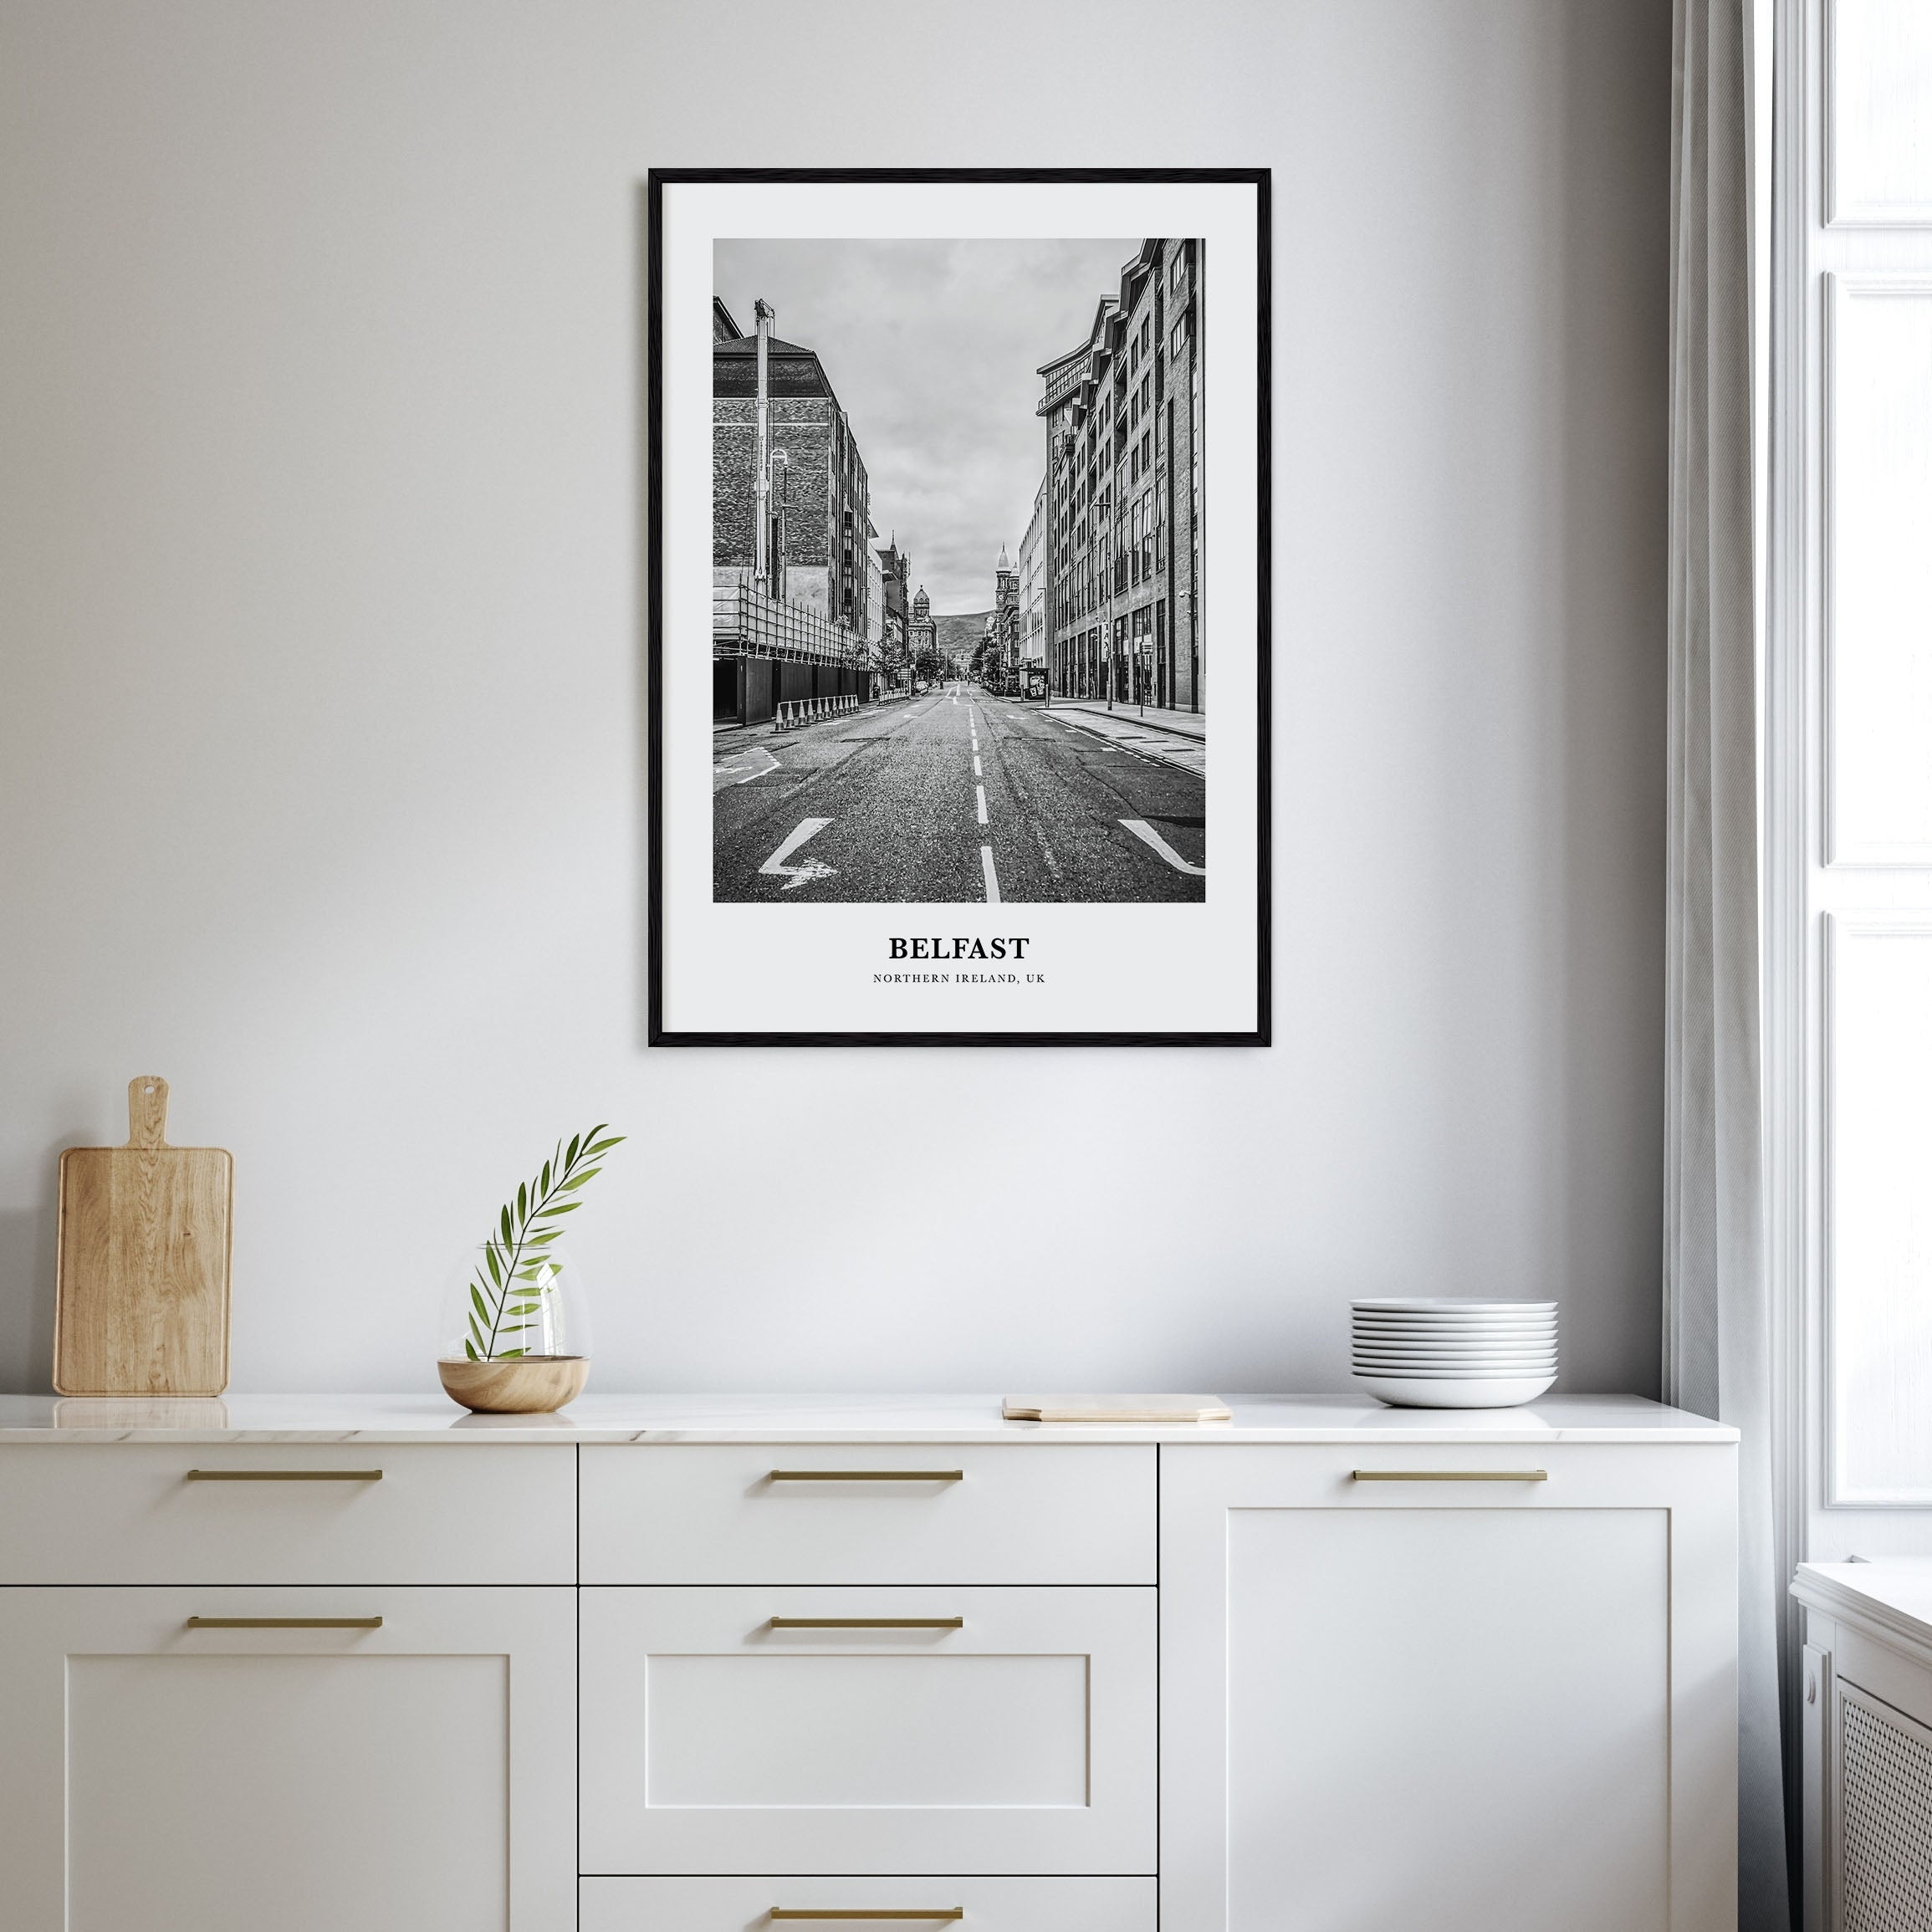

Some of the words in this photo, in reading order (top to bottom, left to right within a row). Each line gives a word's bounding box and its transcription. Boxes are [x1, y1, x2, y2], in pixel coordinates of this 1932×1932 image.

[888, 938, 1030, 959] BELFAST
[873, 974, 949, 983] NORTHERN
[956, 974, 1020, 984] IRELAND,
[1026, 974, 1045, 983] UK
